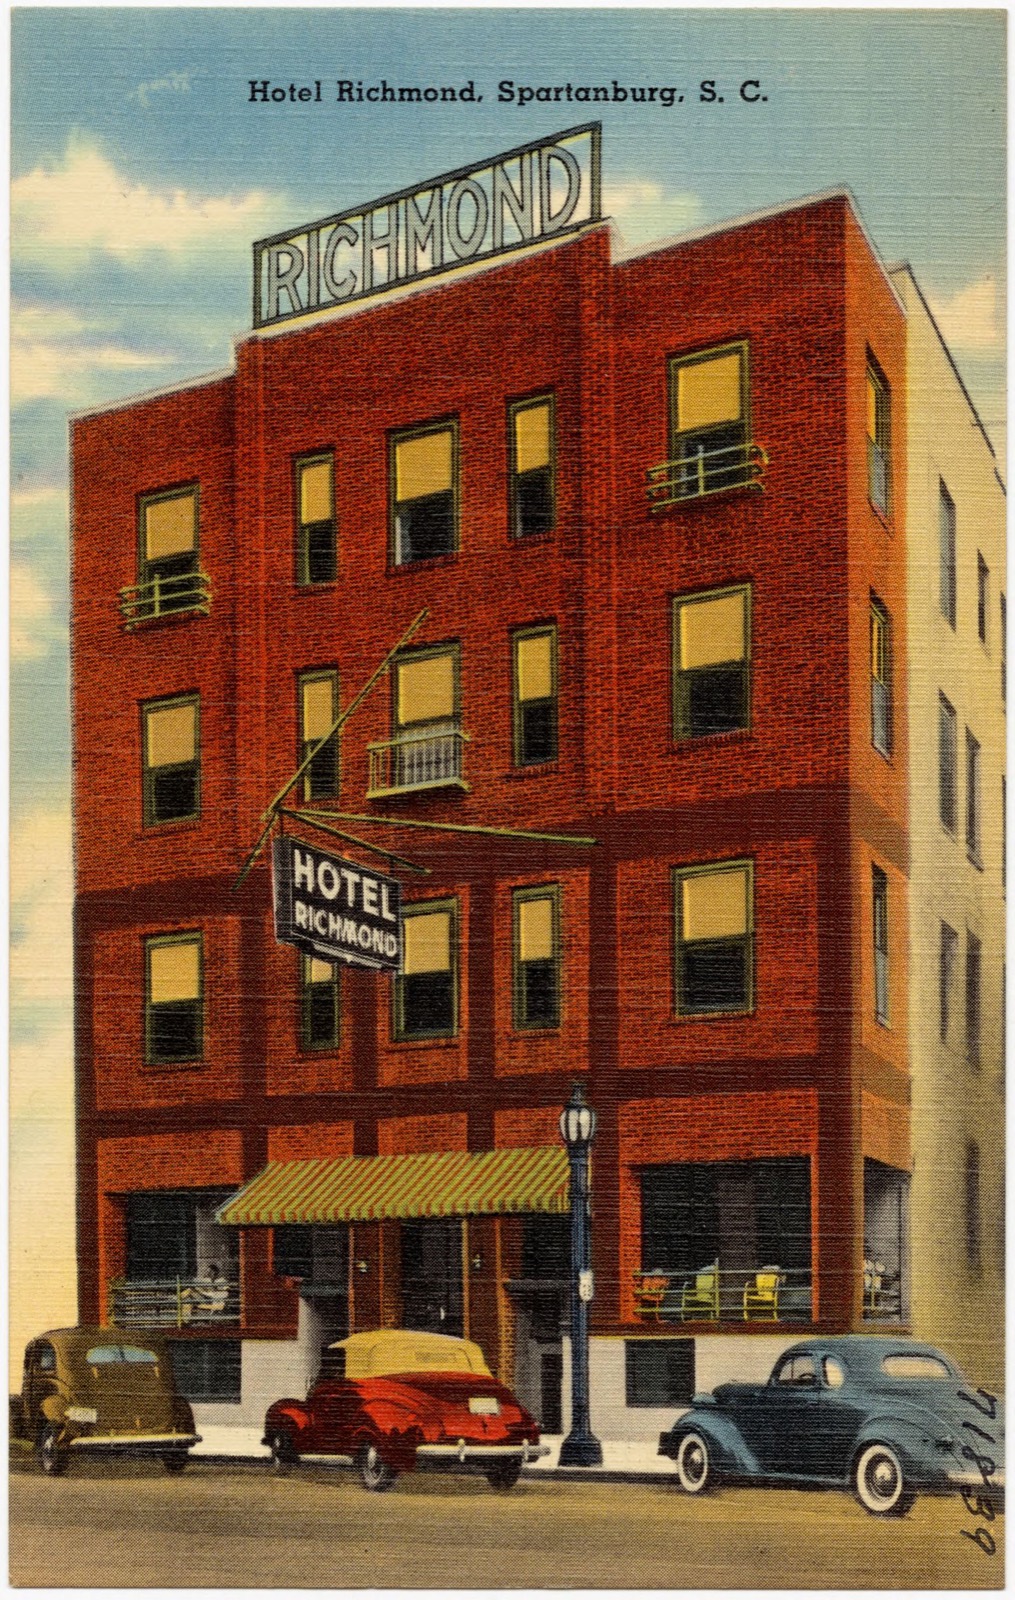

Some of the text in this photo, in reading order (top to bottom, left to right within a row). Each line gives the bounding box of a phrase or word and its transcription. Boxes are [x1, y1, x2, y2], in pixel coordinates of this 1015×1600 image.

[266, 143, 581, 321] RICHMOND
[293, 848, 397, 923] HOTEL
[294, 899, 398, 958] RICHMOND
[956, 1387, 997, 1556] 71839
